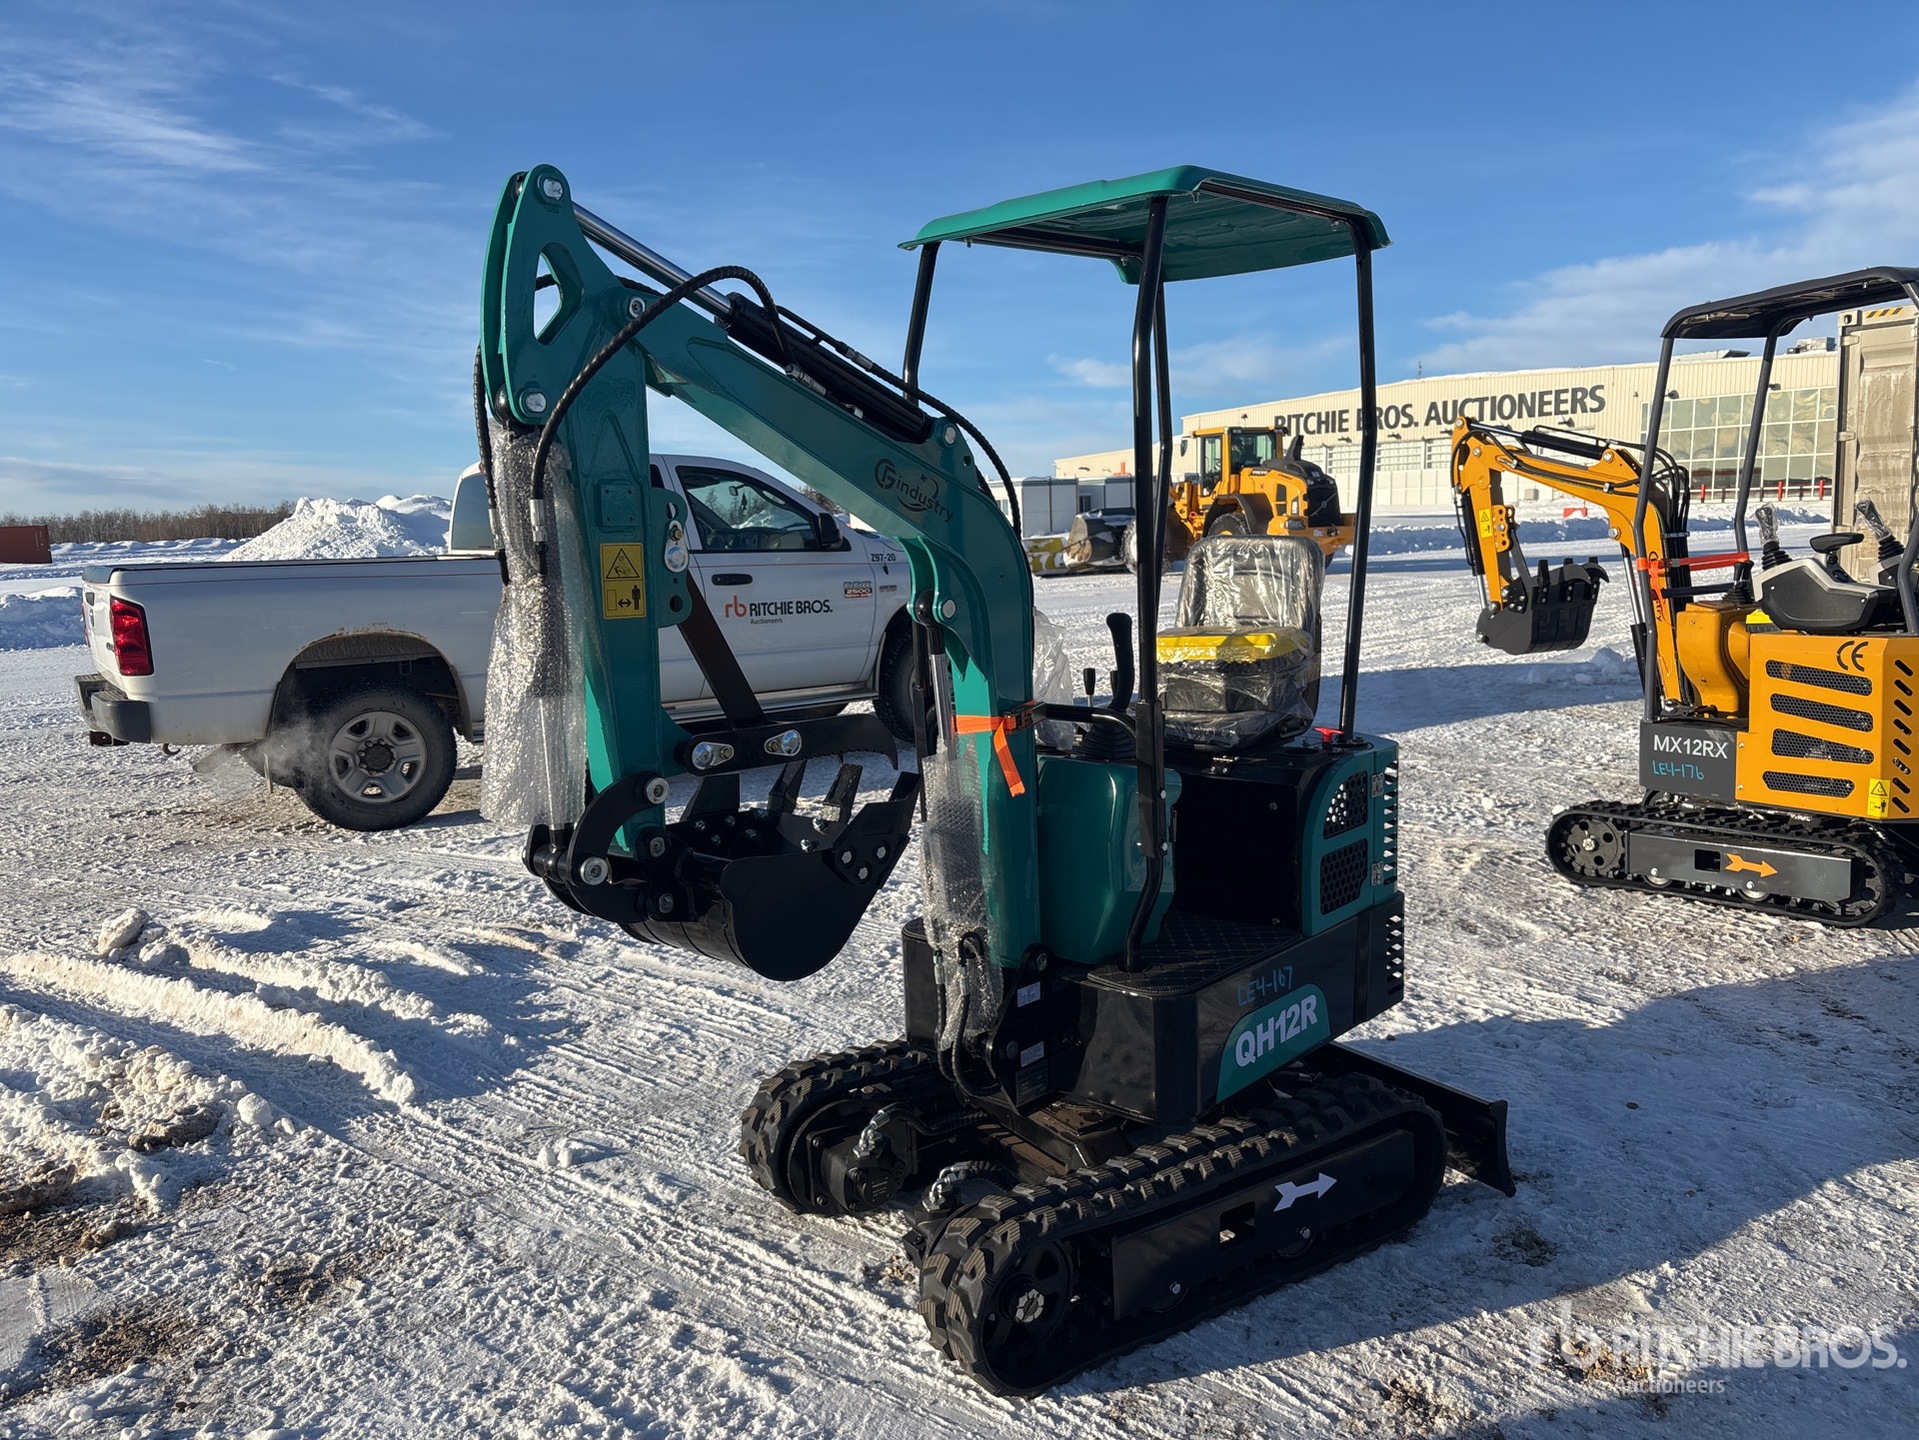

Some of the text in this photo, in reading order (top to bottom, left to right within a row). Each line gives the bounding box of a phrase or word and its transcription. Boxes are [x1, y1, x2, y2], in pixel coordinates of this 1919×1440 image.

[1274, 409, 1349, 436] RITCHIE
[1424, 385, 1606, 426] AUCTIONEERS
[750, 601, 793, 616] RITCHIE
[796, 599, 833, 614] BROS.
[1653, 734, 1728, 759] MX12RX
[1652, 759, 1704, 780] LE4-176
[1235, 994, 1318, 1067] QH12R
